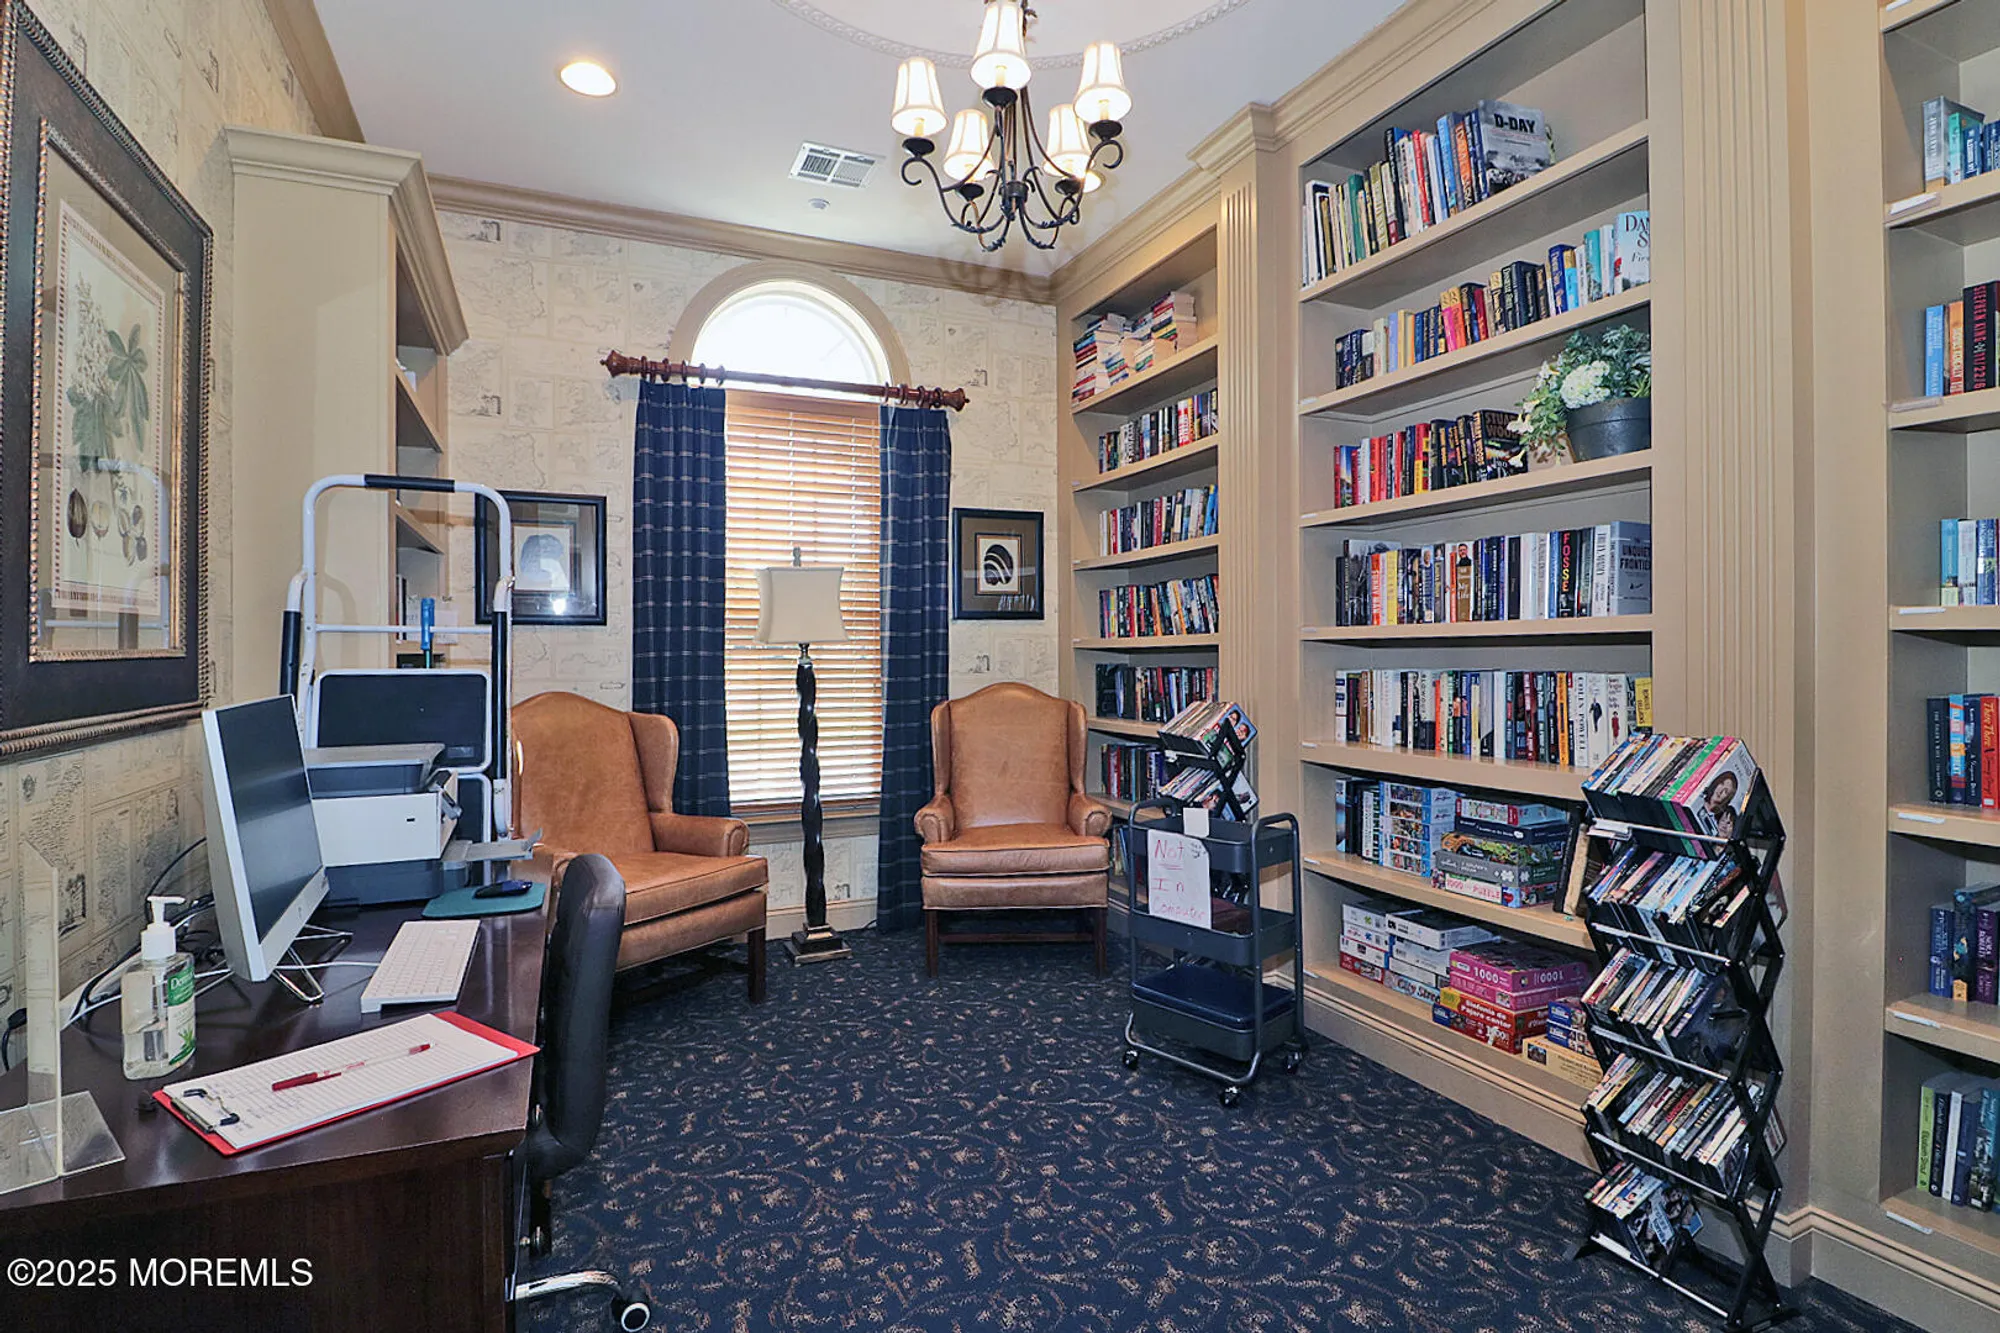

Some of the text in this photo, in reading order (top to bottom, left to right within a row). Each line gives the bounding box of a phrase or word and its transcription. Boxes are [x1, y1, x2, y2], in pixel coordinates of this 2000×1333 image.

[1493, 112, 1537, 134] D-DAY
[1973, 285, 1986, 321] STEPHEN
[1973, 323, 1986, 343] KING
[1562, 532, 1571, 593] FOSSE
[1577, 675, 1585, 751] COLIN POWELL
[1983, 702, 1994, 725] There
[1983, 725, 1994, 747] There
[1154, 839, 1185, 860] Not
[1151, 877, 1185, 893] In
[1473, 966, 1499, 984] 1000
